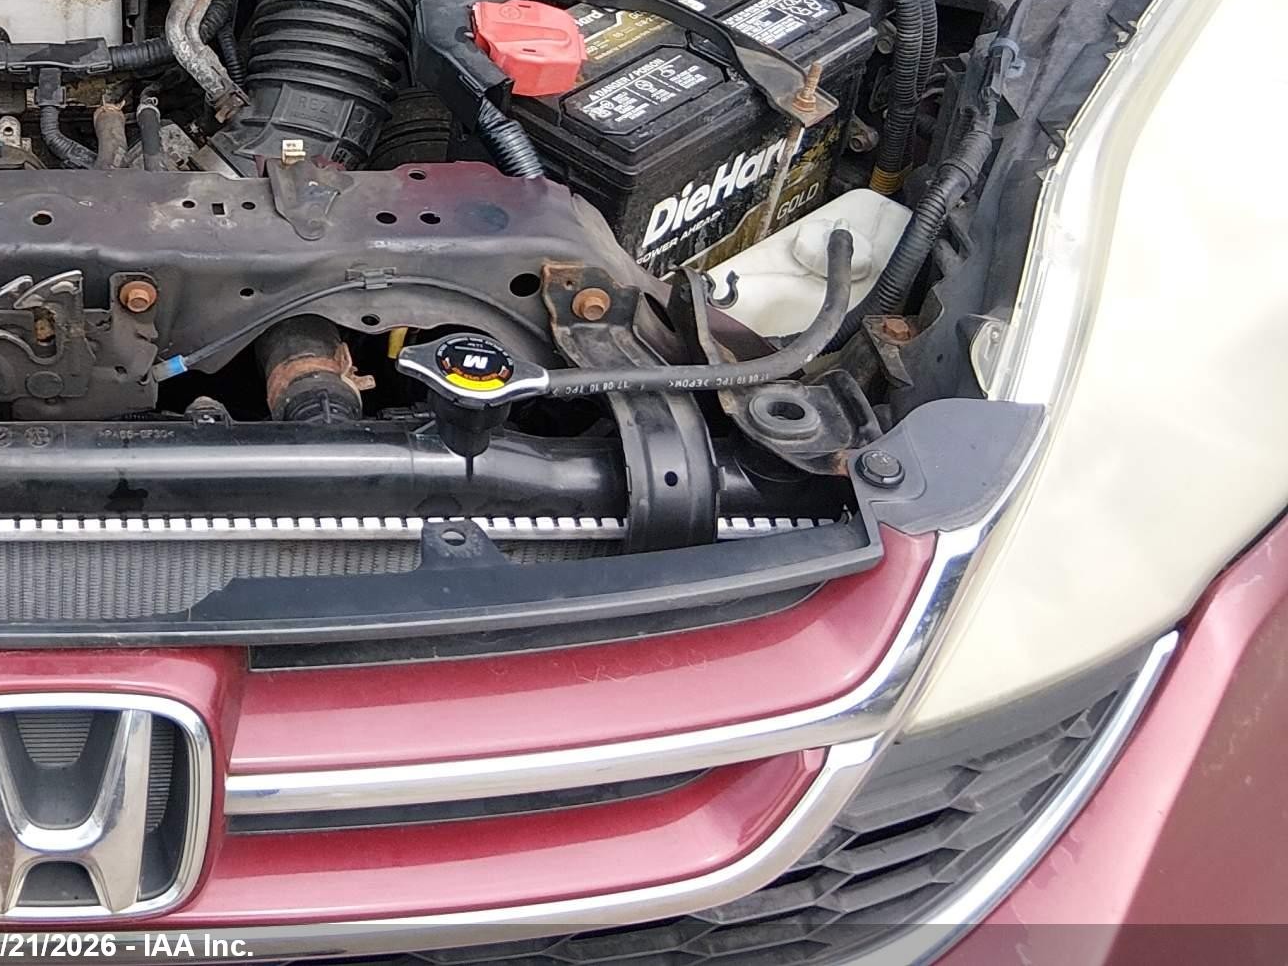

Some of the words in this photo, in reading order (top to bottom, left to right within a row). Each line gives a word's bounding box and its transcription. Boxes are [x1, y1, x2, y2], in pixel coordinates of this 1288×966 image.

[594, 76, 631, 97] DANGER
[632, 58, 665, 76] POISON
[776, 182, 820, 221] GOLD
[680, 211, 721, 241] AHEAD
